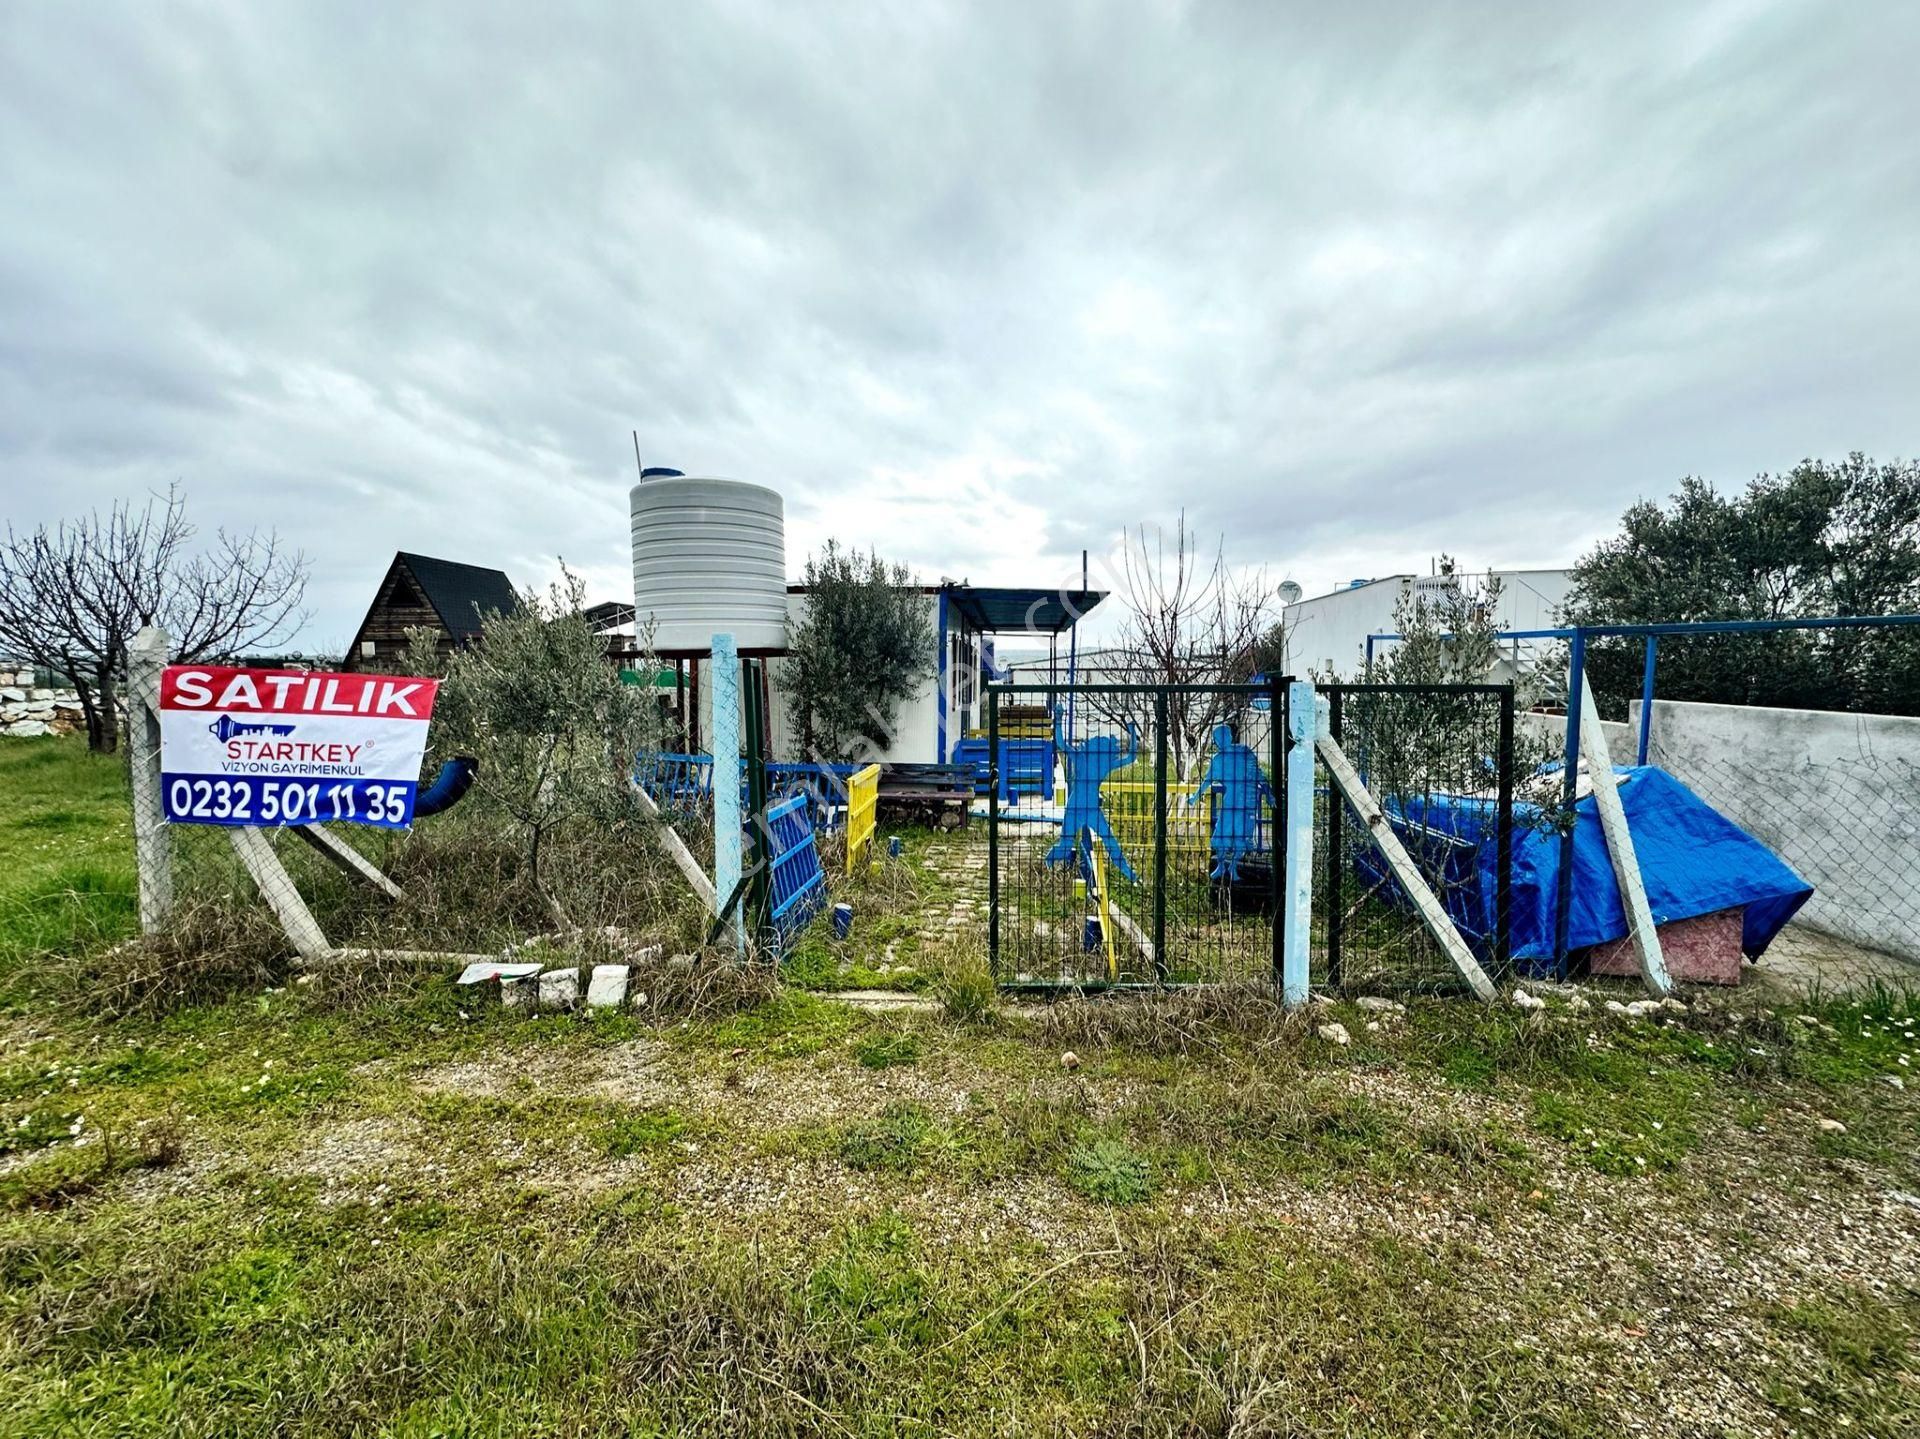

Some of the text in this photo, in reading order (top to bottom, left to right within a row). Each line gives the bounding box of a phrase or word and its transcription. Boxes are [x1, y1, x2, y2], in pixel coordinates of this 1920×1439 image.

[173, 671, 423, 715] SATILIK
[227, 740, 361, 762] STARTKEY
[222, 761, 365, 776] VİZYON GAYRİMENKUL
[171, 779, 408, 823] 0232 501 11 35
